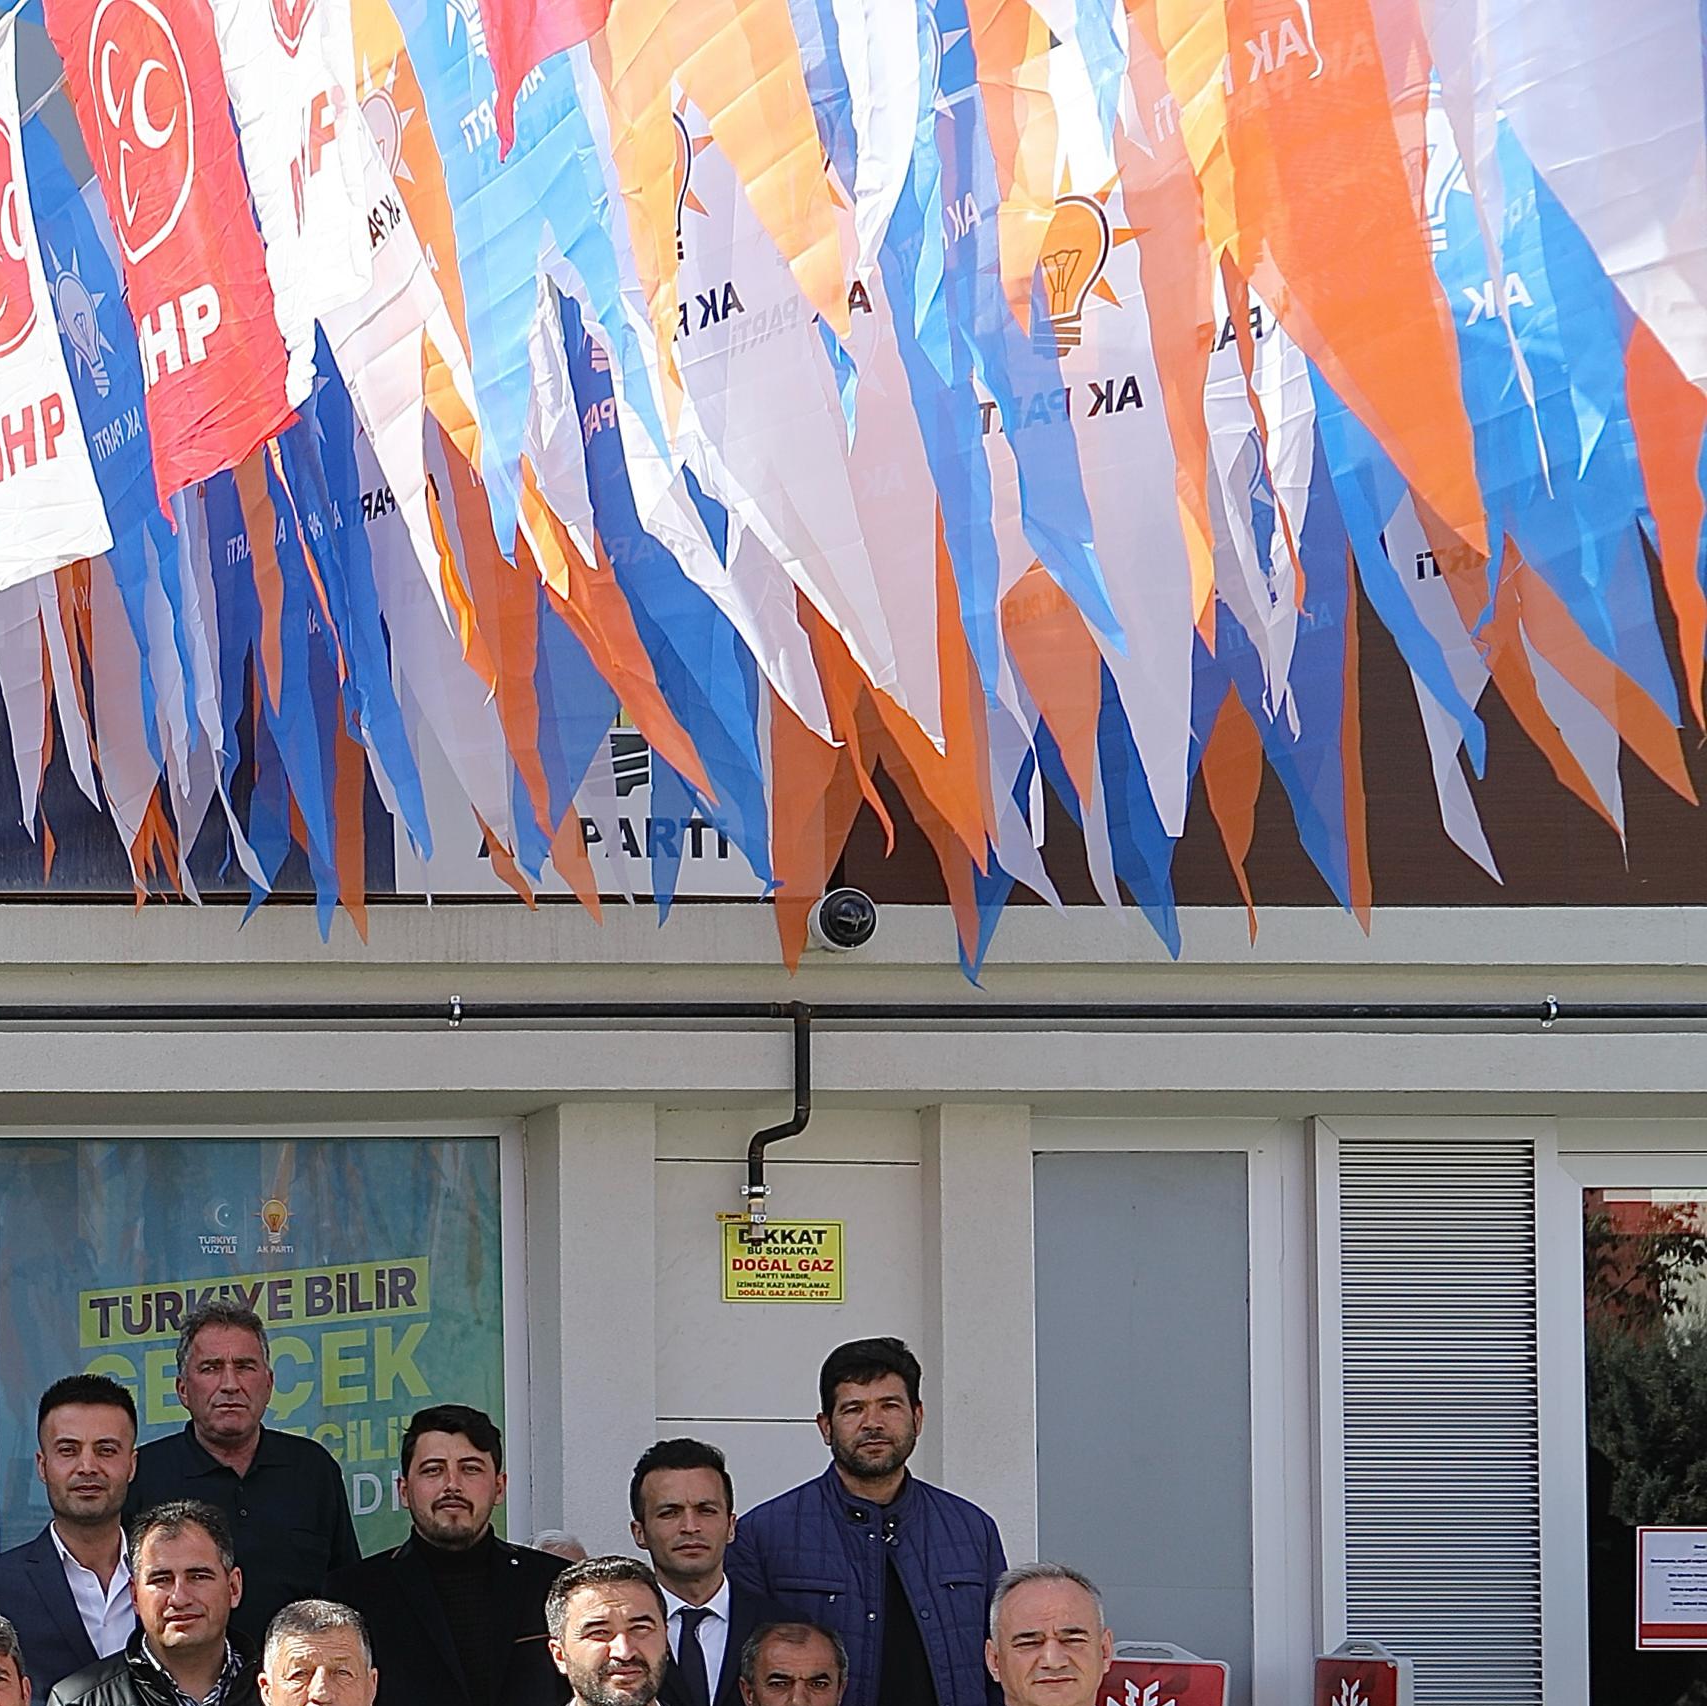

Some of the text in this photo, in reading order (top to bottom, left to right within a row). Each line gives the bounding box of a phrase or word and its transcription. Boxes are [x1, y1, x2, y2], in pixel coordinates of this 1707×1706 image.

[139, 283, 222, 394] HP
[738, 1228, 828, 1245] DKKAT
[747, 1246, 819, 1255] BU SOKAKTA
[732, 1256, 835, 1272] DOĞAL GAZ
